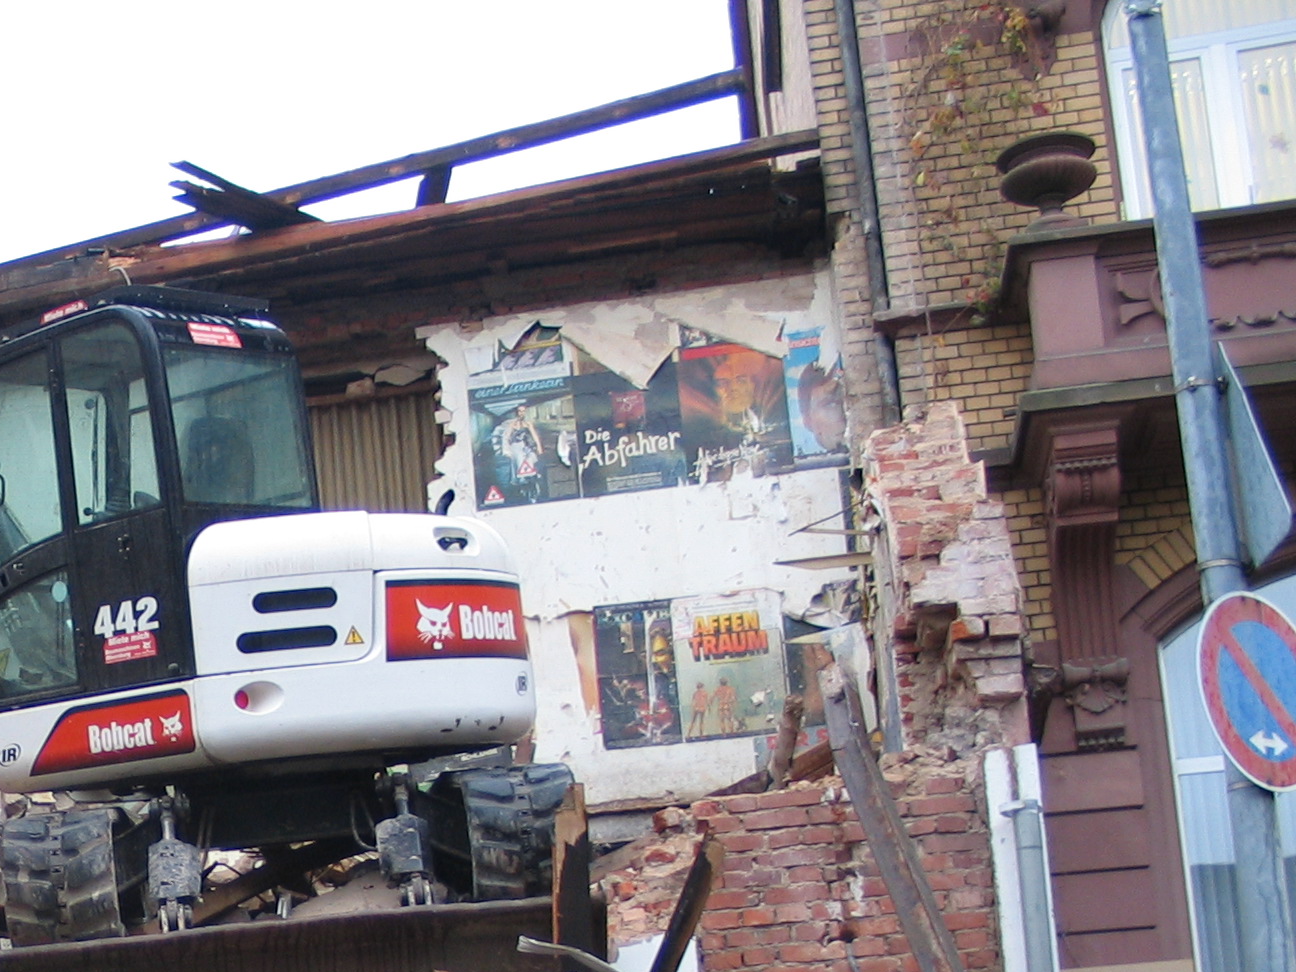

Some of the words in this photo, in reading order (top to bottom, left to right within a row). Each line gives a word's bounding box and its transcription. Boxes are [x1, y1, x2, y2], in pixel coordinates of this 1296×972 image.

[583, 431, 681, 468] Abfahrer
[584, 427, 611, 444] Die
[94, 596, 160, 638] 442
[458, 604, 517, 641] Bobcat
[693, 610, 760, 637] AFFEN
[688, 630, 769, 662] TRAUM
[88, 718, 155, 754] Bobcat
[0, 745, 20, 765] IR
